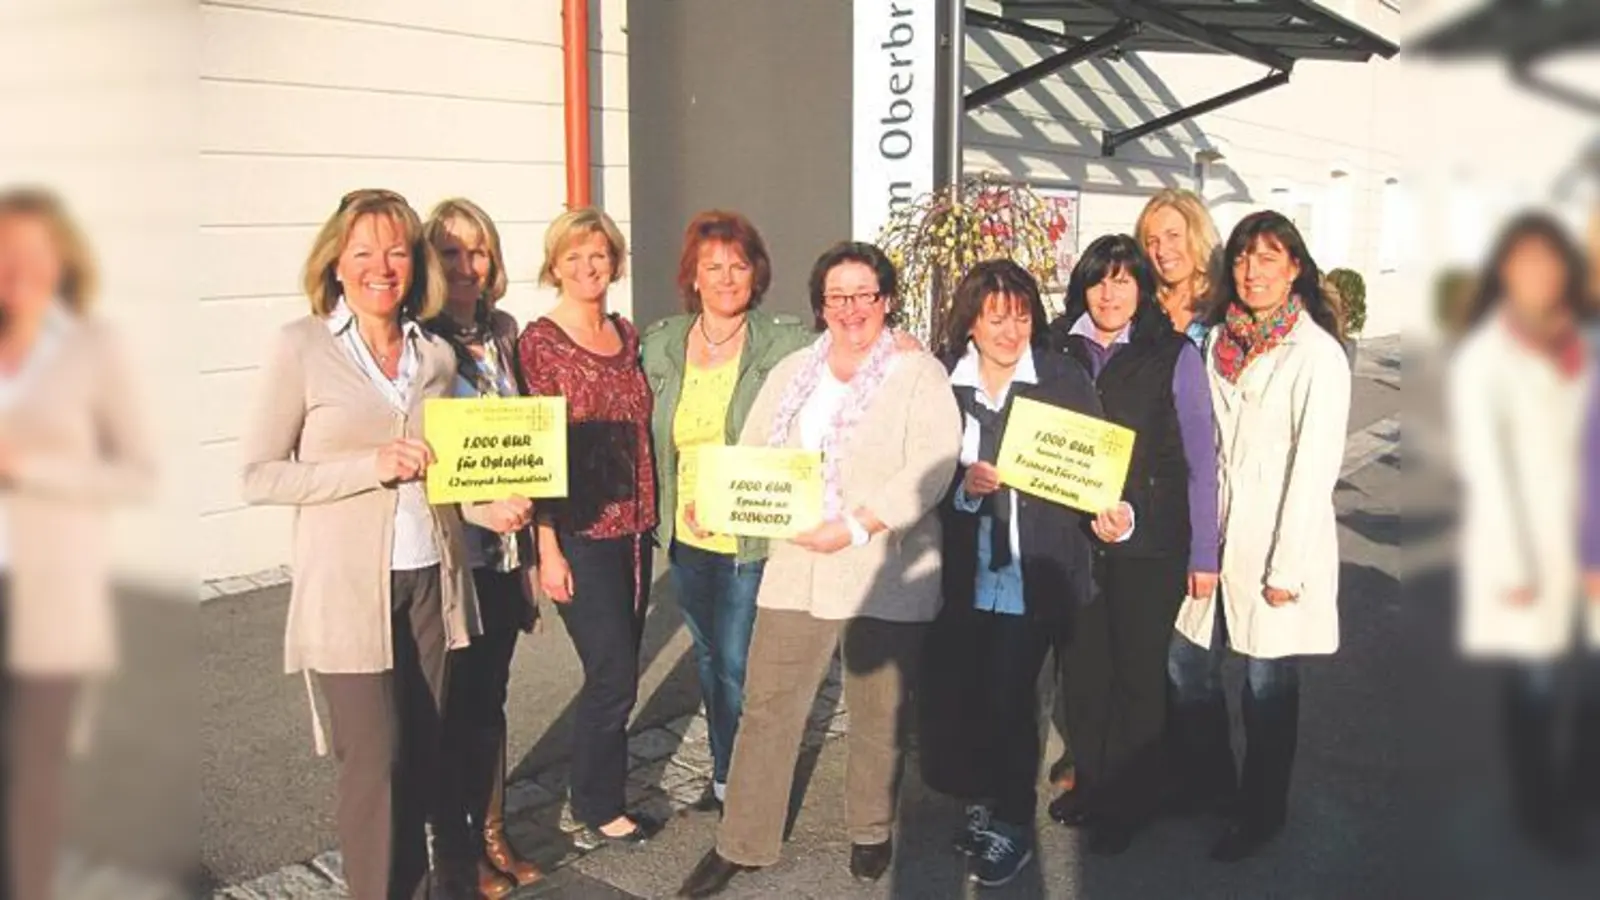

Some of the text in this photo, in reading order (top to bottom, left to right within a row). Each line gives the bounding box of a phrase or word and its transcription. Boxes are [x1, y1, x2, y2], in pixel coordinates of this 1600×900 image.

[879, 2, 914, 160] Oberbr
[463, 436, 498, 448] 1.000
[456, 454, 544, 472] für Ostafrika
